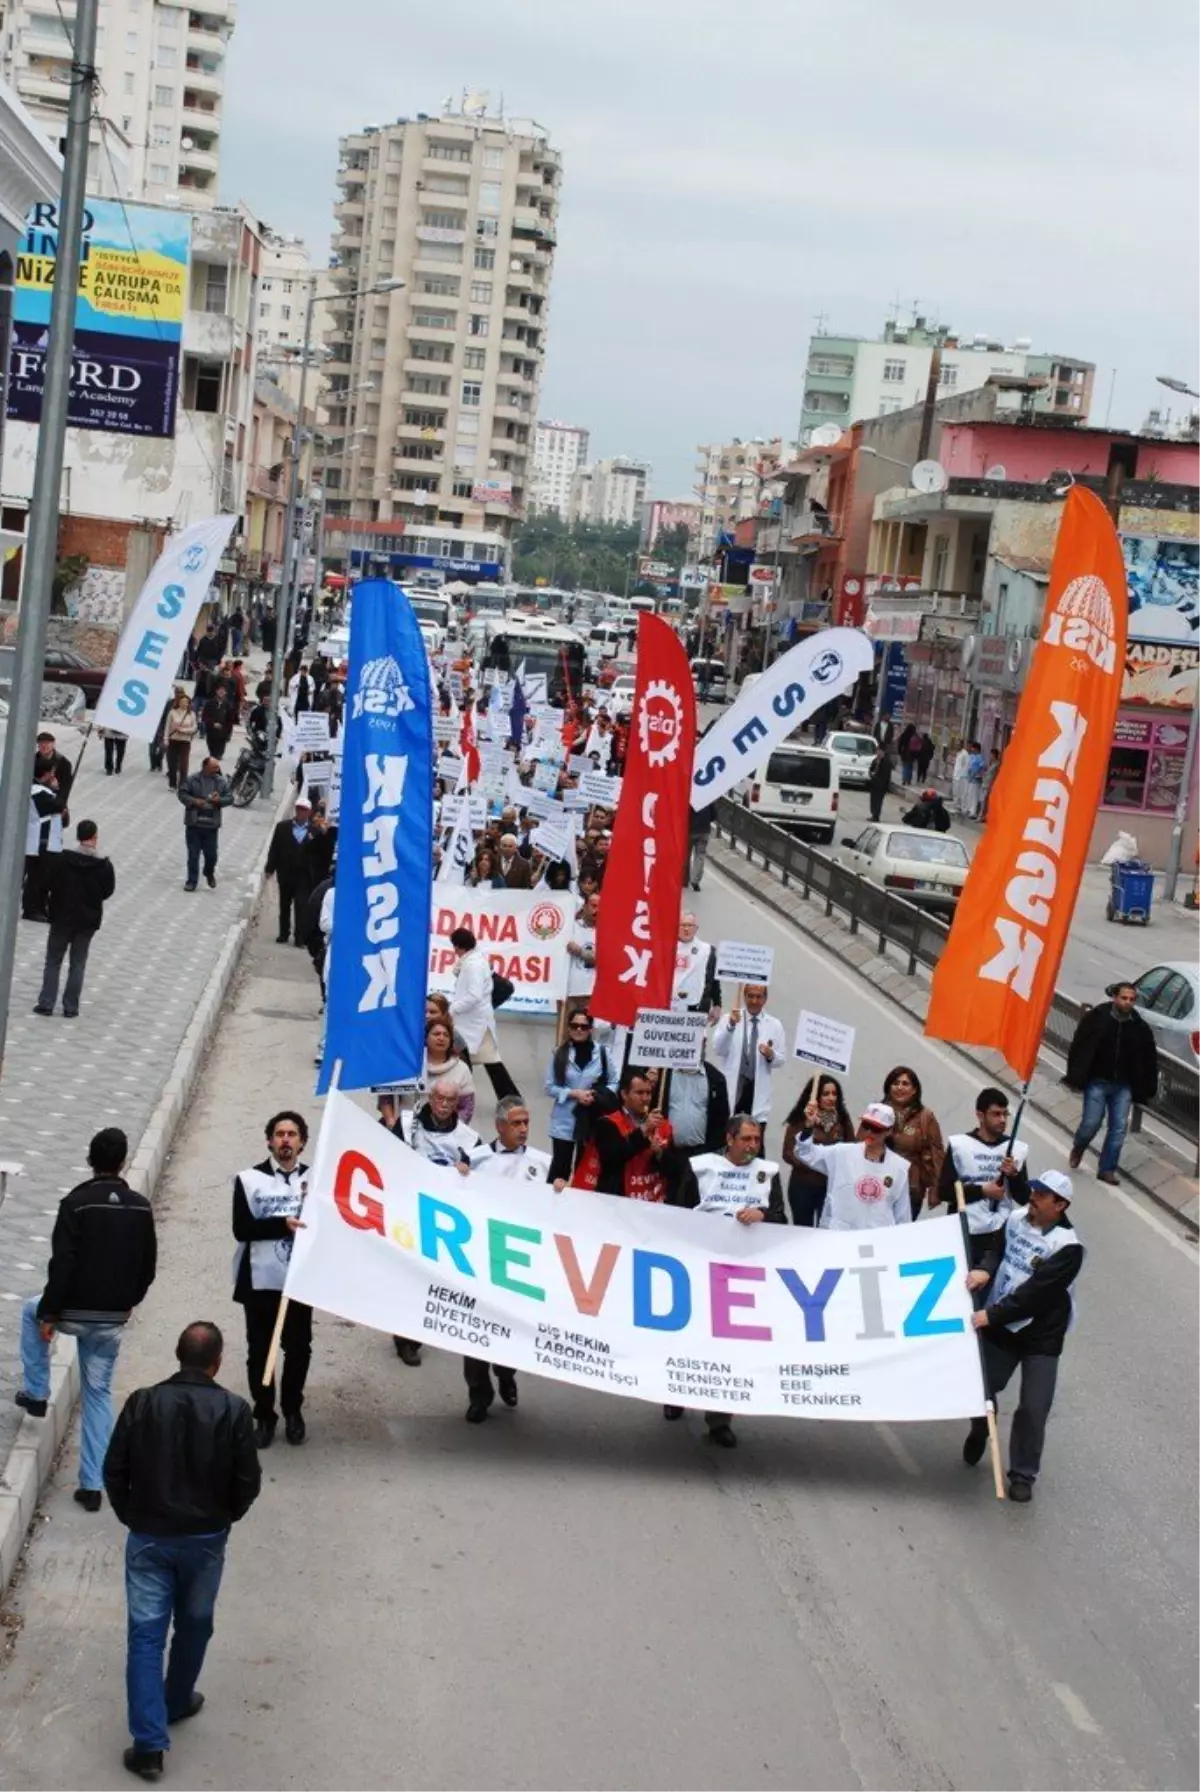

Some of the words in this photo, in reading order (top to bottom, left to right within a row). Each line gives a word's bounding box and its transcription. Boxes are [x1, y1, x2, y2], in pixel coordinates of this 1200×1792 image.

[80, 390, 137, 407] Academy
[117, 584, 186, 717] SES
[693, 682, 806, 787] SES
[430, 908, 519, 943] DANA
[636, 1012, 685, 1027] PERFORMANS
[643, 1029, 696, 1042] GÜVENCELİ
[637, 1045, 666, 1058] TEMEL
[668, 1047, 696, 1060] ÜCRET
[428, 1284, 477, 1309] HEKİM
[425, 1301, 512, 1340] DİYETİSYEN
[423, 1317, 491, 1348] BİYOLOĞ
[537, 1323, 561, 1340] DİŞ
[564, 1330, 611, 1354] HEKİM
[535, 1337, 616, 1369] LABORANT
[535, 1352, 605, 1380] TAŞERON
[608, 1373, 639, 1387] İŞÇİ
[666, 1356, 732, 1373] ASİSTAN
[779, 1363, 850, 1379] HEMŞİRE
[666, 1370, 754, 1388] TEKNİSYEN
[780, 1379, 812, 1391] EBE
[667, 1383, 751, 1401] SEKRETER
[781, 1392, 862, 1406] TEKNİKER
